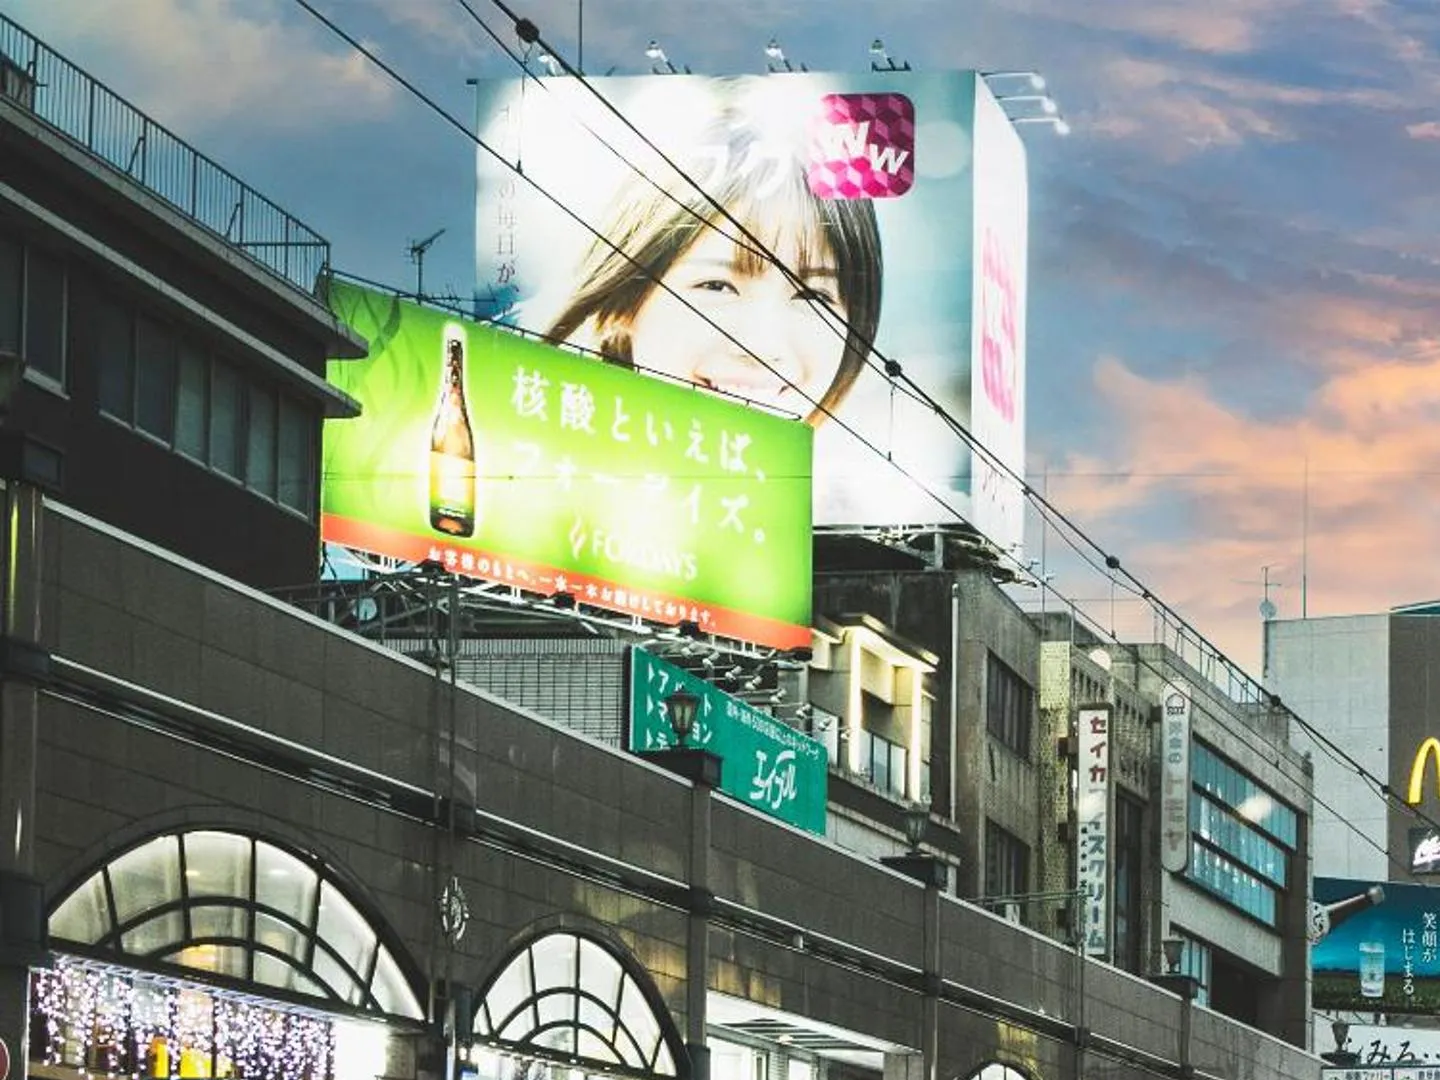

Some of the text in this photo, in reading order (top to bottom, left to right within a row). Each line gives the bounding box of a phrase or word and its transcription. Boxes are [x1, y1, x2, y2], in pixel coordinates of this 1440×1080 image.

[511, 364, 767, 482] 核酸といえば、
[1402, 928, 1416, 995] はじまる
[1422, 912, 1437, 963] 笑顔が
